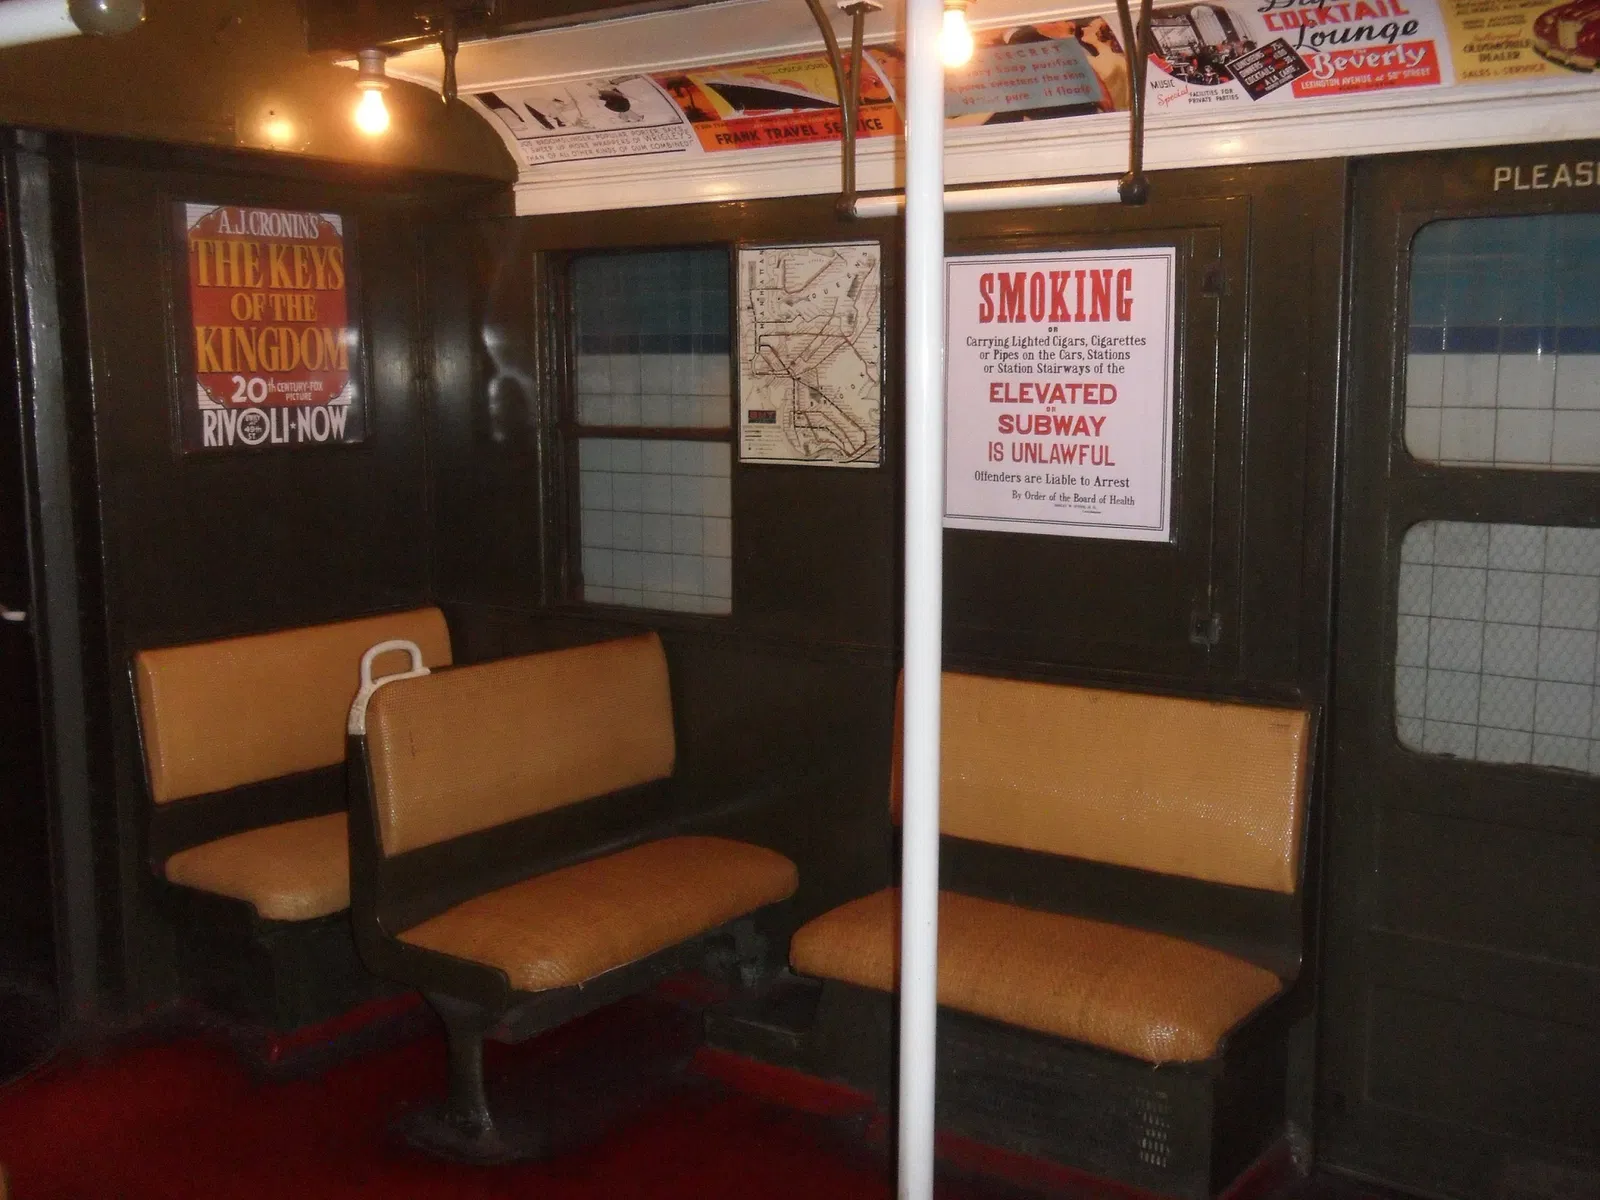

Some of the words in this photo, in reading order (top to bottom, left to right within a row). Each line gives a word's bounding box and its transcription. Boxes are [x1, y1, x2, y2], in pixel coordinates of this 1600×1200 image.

[1263, 0, 1409, 31] COCKTAIL
[1292, 19, 1419, 52] Lounge
[1312, 44, 1427, 79] Beverly
[1042, 73, 1060, 82] the
[1150, 80, 1176, 89] MUSIC
[1244, 65, 1275, 86] COCKTAILS
[1301, 77, 1339, 90] LEXINGTON
[1342, 74, 1372, 86] AVENUE
[1157, 84, 1189, 107] Special
[1188, 96, 1212, 104] PRIVATE
[1189, 89, 1218, 97] FACILITIES
[715, 129, 761, 144] FRANK
[764, 125, 818, 139] TRAVEL
[824, 118, 884, 134] SEICE
[572, 149, 592, 157] OTHER
[1494, 161, 1600, 191] PLEAS
[189, 238, 264, 288] THE
[268, 244, 345, 290] KEYS
[231, 292, 266, 321] OF
[268, 293, 318, 321] THE
[979, 268, 1134, 324] SMOKING
[195, 325, 349, 373] KINGDOM
[966, 335, 1010, 348] Carrying
[1012, 335, 1050, 348] Lighted
[1052, 335, 1088, 348] Cigars,
[1091, 334, 1147, 347] Cigarettes
[979, 351, 990, 360] or
[993, 349, 1019, 362] Pipes
[1022, 351, 1035, 360] on
[1038, 349, 1056, 360] the
[1059, 349, 1085, 361] Cars,
[1087, 348, 1131, 361] Stations
[983, 364, 994, 373] or
[997, 363, 1033, 374] Station
[1037, 362, 1091, 376] Stairways
[1093, 362, 1104, 374] of
[1107, 363, 1125, 374] the
[277, 381, 323, 393] CENTURY-FOX
[285, 392, 312, 401] PICTURE
[989, 382, 1118, 405] ELEVATED
[203, 407, 290, 447] RIVOLI
[297, 405, 348, 442] NOW
[998, 415, 1106, 436] SUBWAY
[988, 441, 1004, 462] IS
[1012, 442, 1116, 466] UNLAWFUL
[974, 470, 1021, 483] Offenders
[1024, 475, 1042, 484] are
[1045, 473, 1077, 486] Liable
[1080, 475, 1090, 486] to
[1094, 476, 1130, 488] Arrest
[1012, 490, 1023, 501] By
[1024, 490, 1046, 501] Order
[1049, 492, 1057, 501] of
[1059, 492, 1071, 502] the
[1073, 493, 1096, 503] Board
[1099, 494, 1107, 504] of
[1109, 494, 1135, 506] Health
